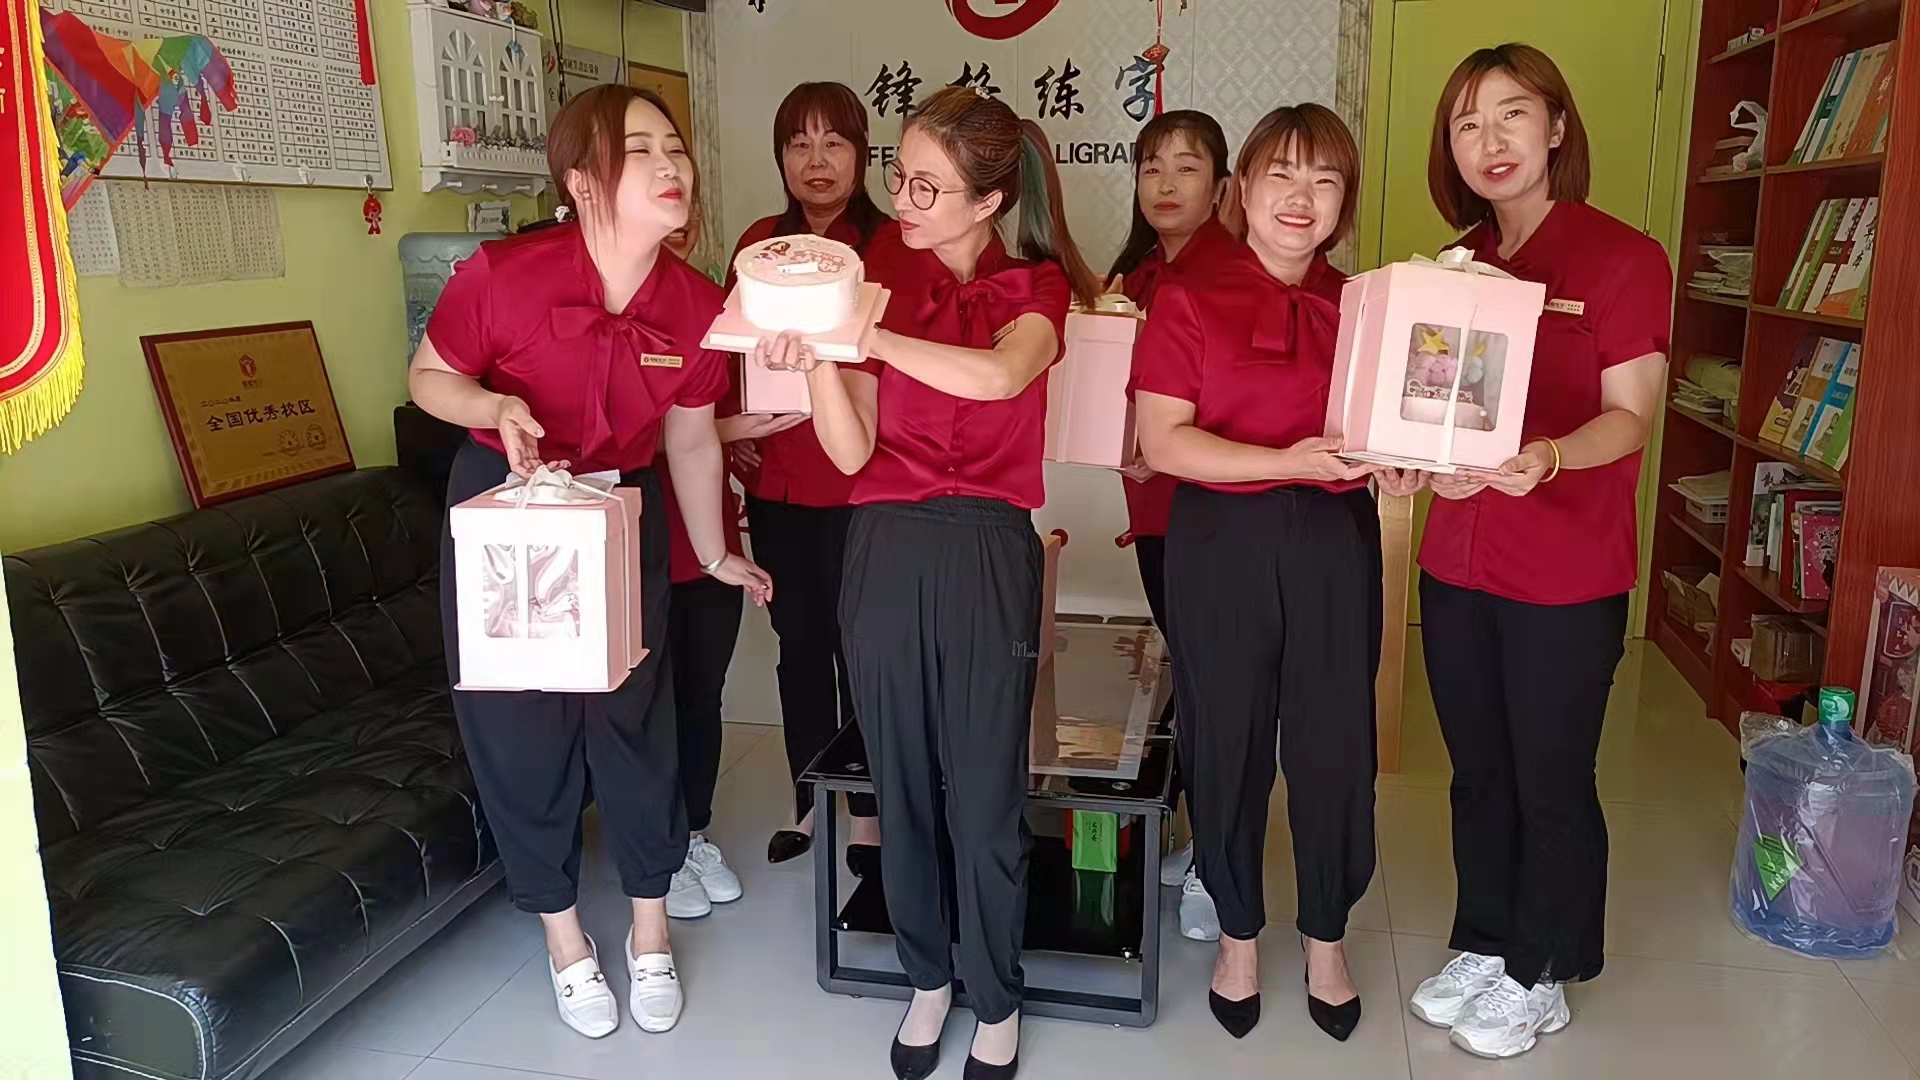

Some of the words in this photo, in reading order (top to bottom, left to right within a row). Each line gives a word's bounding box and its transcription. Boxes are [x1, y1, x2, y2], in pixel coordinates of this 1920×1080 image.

[1055, 142, 1136, 164] LIGRA
[207, 400, 316, 431] 全国优秀校区
